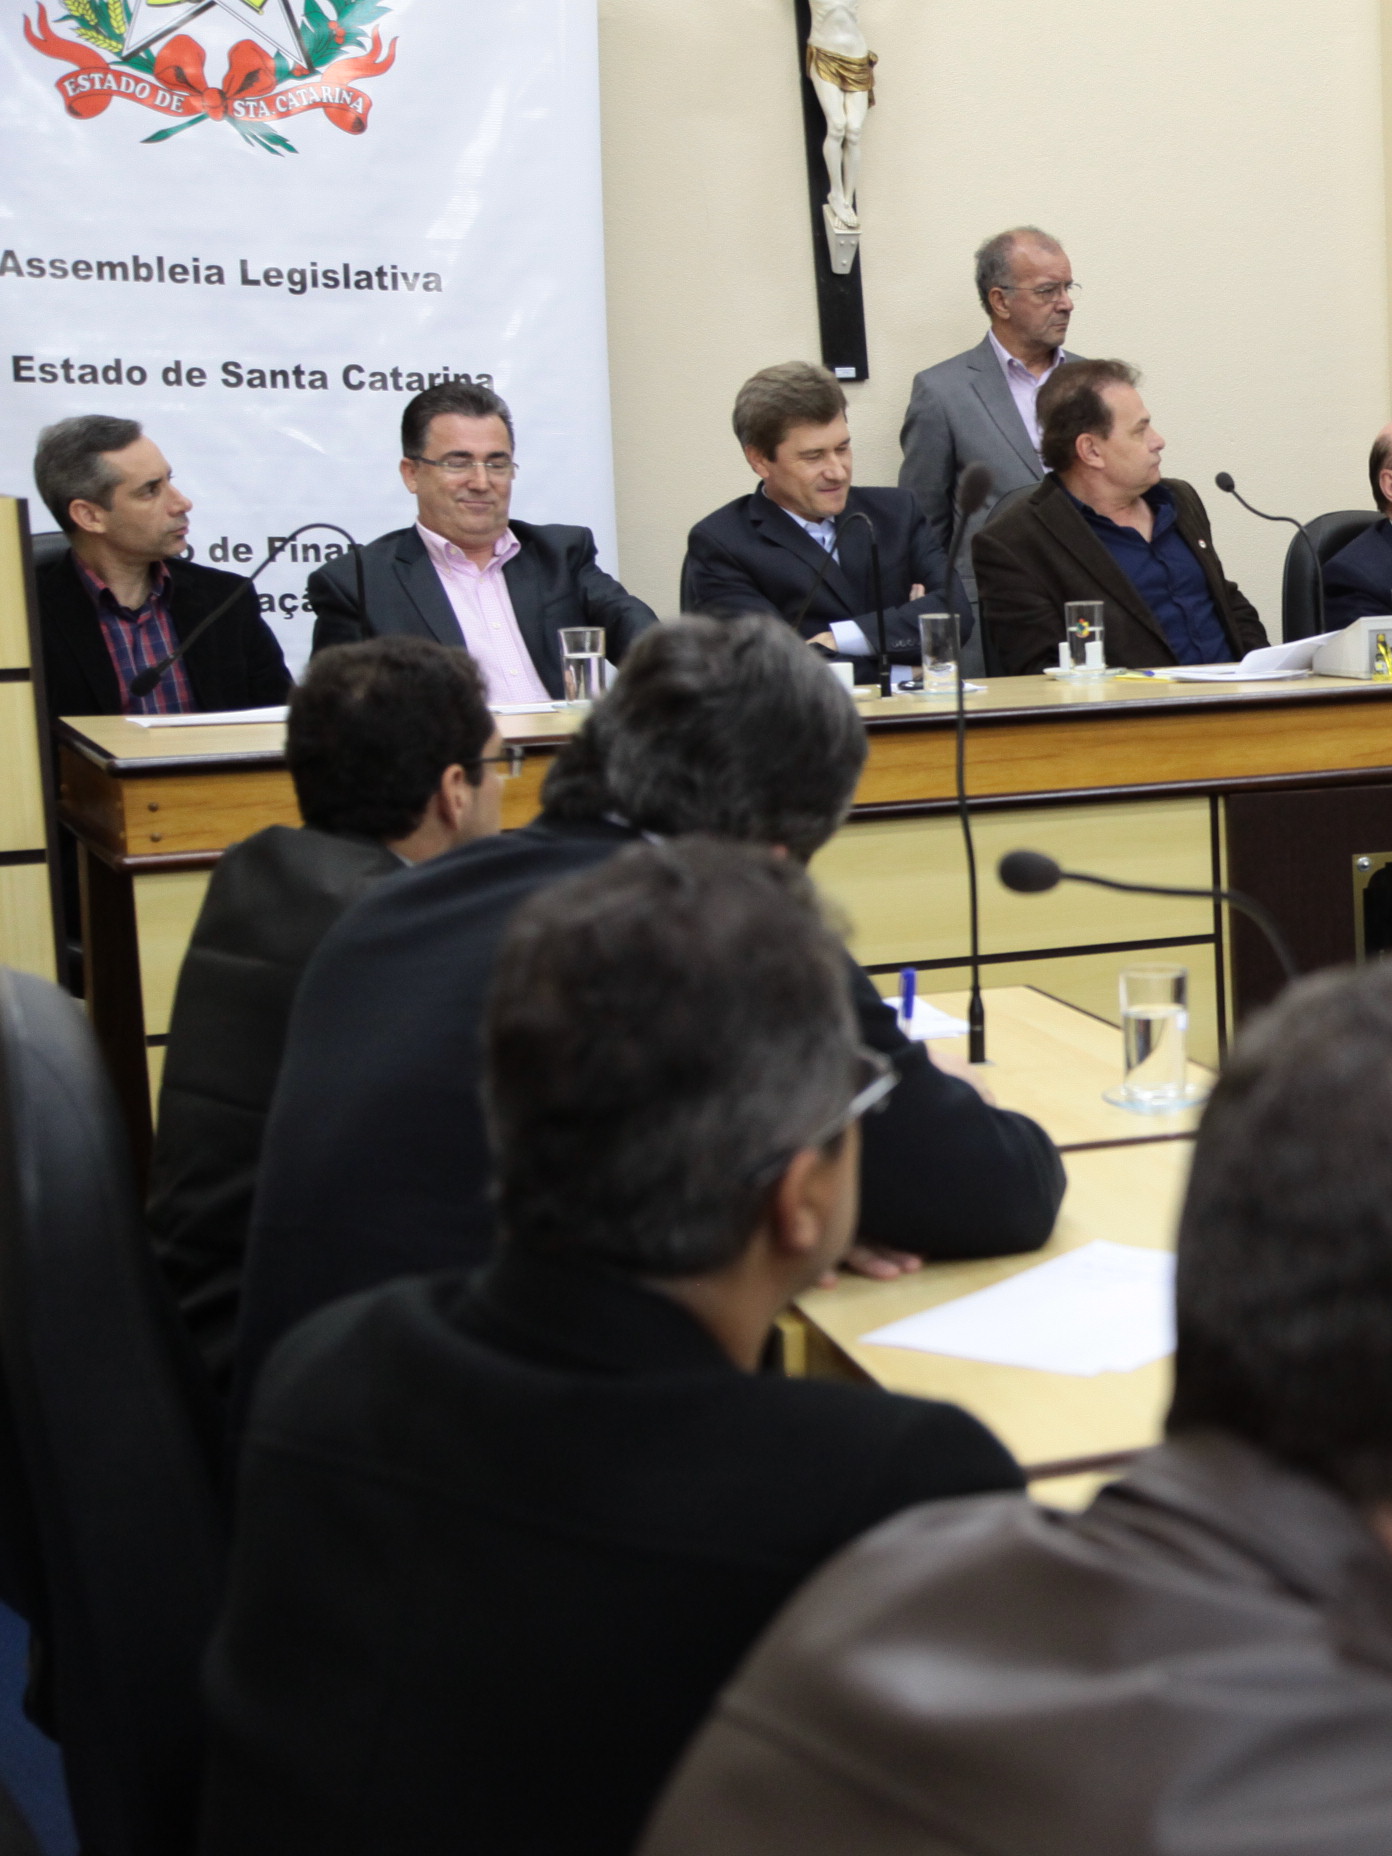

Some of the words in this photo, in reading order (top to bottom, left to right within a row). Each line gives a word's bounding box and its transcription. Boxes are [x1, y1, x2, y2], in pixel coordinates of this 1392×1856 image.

[63, 72, 151, 98] ESTADO
[153, 93, 185, 113] DE
[277, 88, 364, 114] CATARINA
[0, 249, 226, 285] Assembleia
[239, 258, 443, 296] Legislativa
[12, 354, 148, 386] Estado
[161, 359, 208, 388] de
[220, 360, 330, 390] Santa
[208, 536, 253, 563] de
